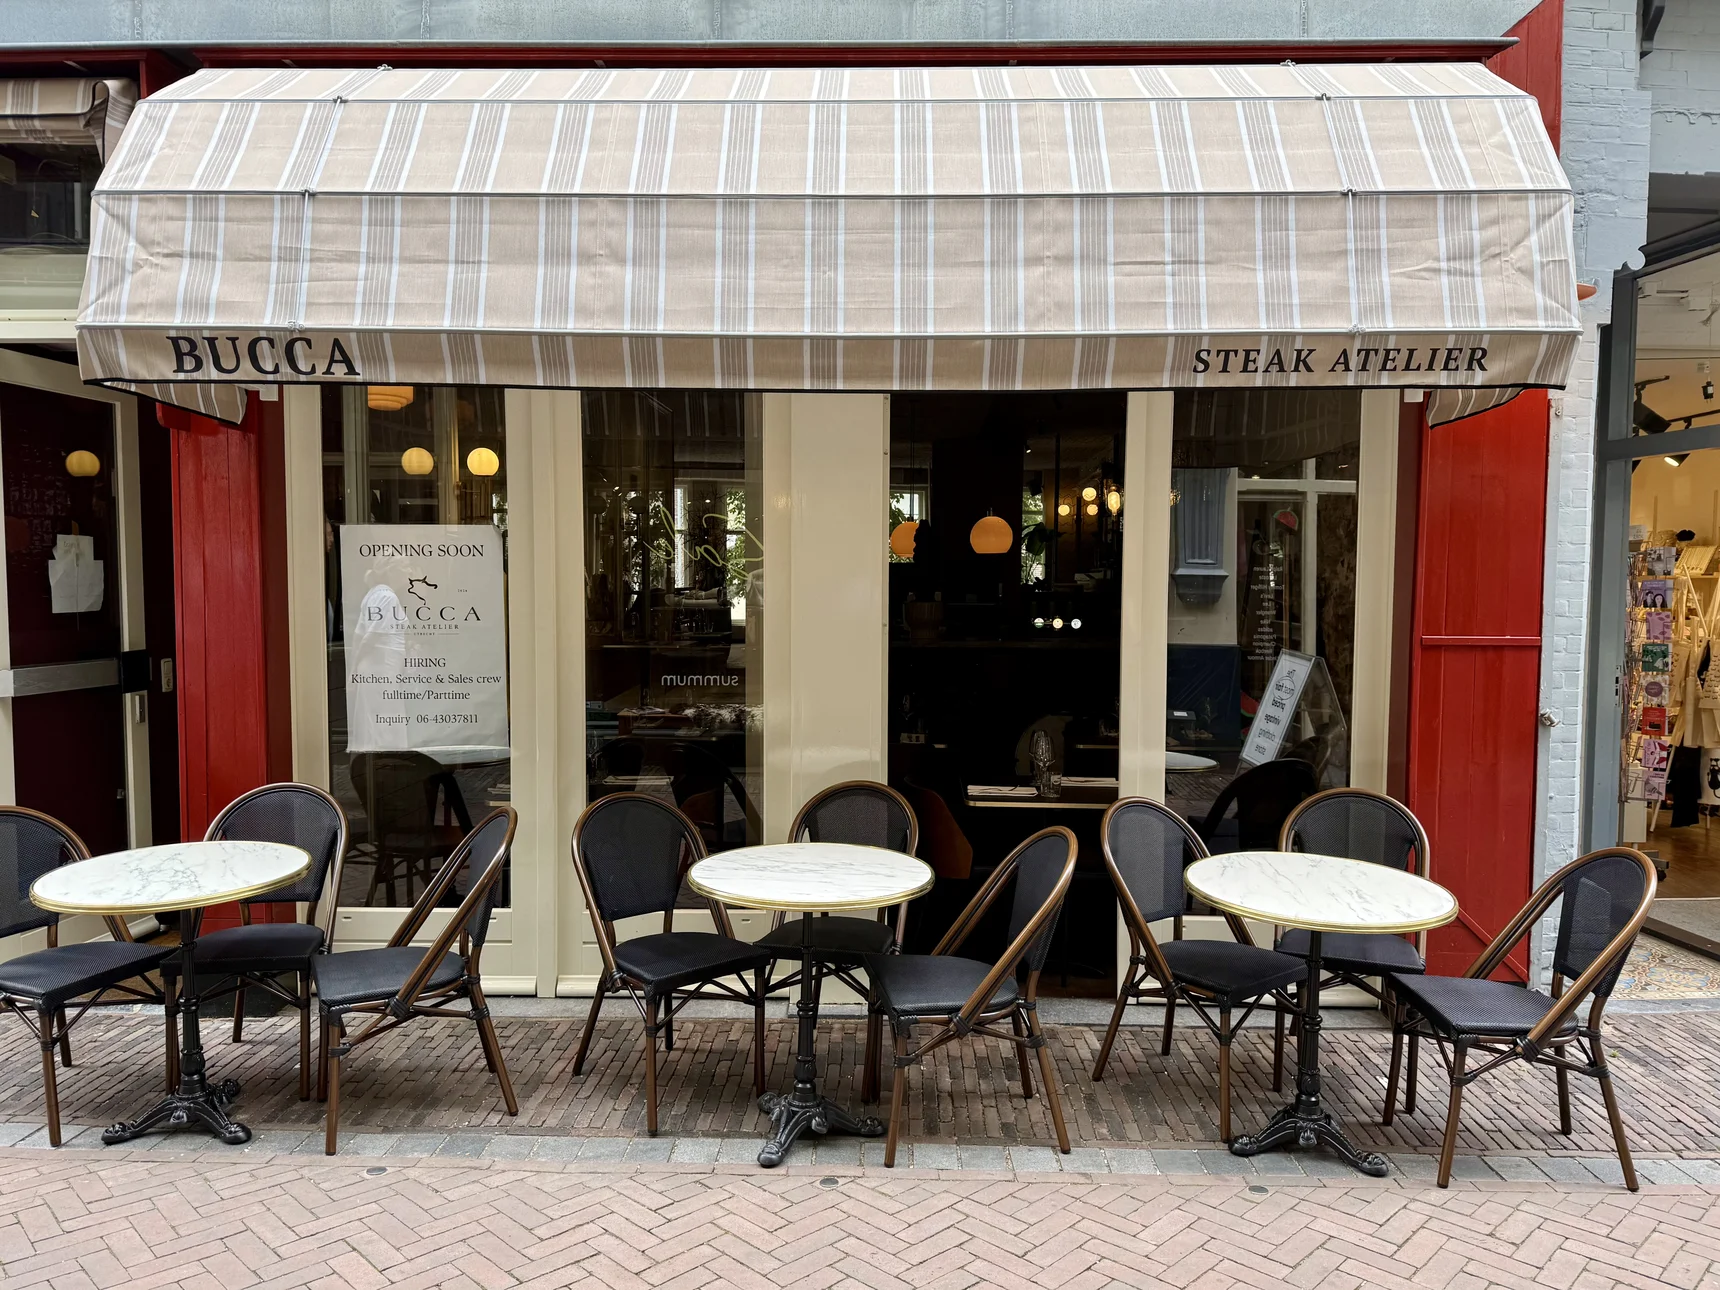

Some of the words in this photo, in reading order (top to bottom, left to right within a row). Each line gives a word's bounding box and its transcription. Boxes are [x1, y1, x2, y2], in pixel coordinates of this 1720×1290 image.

[166, 335, 362, 377] BUCCA
[1193, 347, 1317, 374] STEAK
[1329, 345, 1489, 373] ATELIER
[359, 544, 433, 558] OPENING
[437, 544, 485, 558] SOON
[367, 605, 481, 622] BUCCA
[403, 657, 447, 668] HIRING
[351, 674, 393, 685] Kitchen,
[395, 674, 432, 684] Service
[435, 674, 445, 684] &
[448, 674, 474, 684] Sales
[476, 676, 502, 684] crew
[382, 689, 471, 701] fulltime/Parttime
[375, 713, 411, 727] Inquiry
[416, 713, 479, 724] 06-43037811
